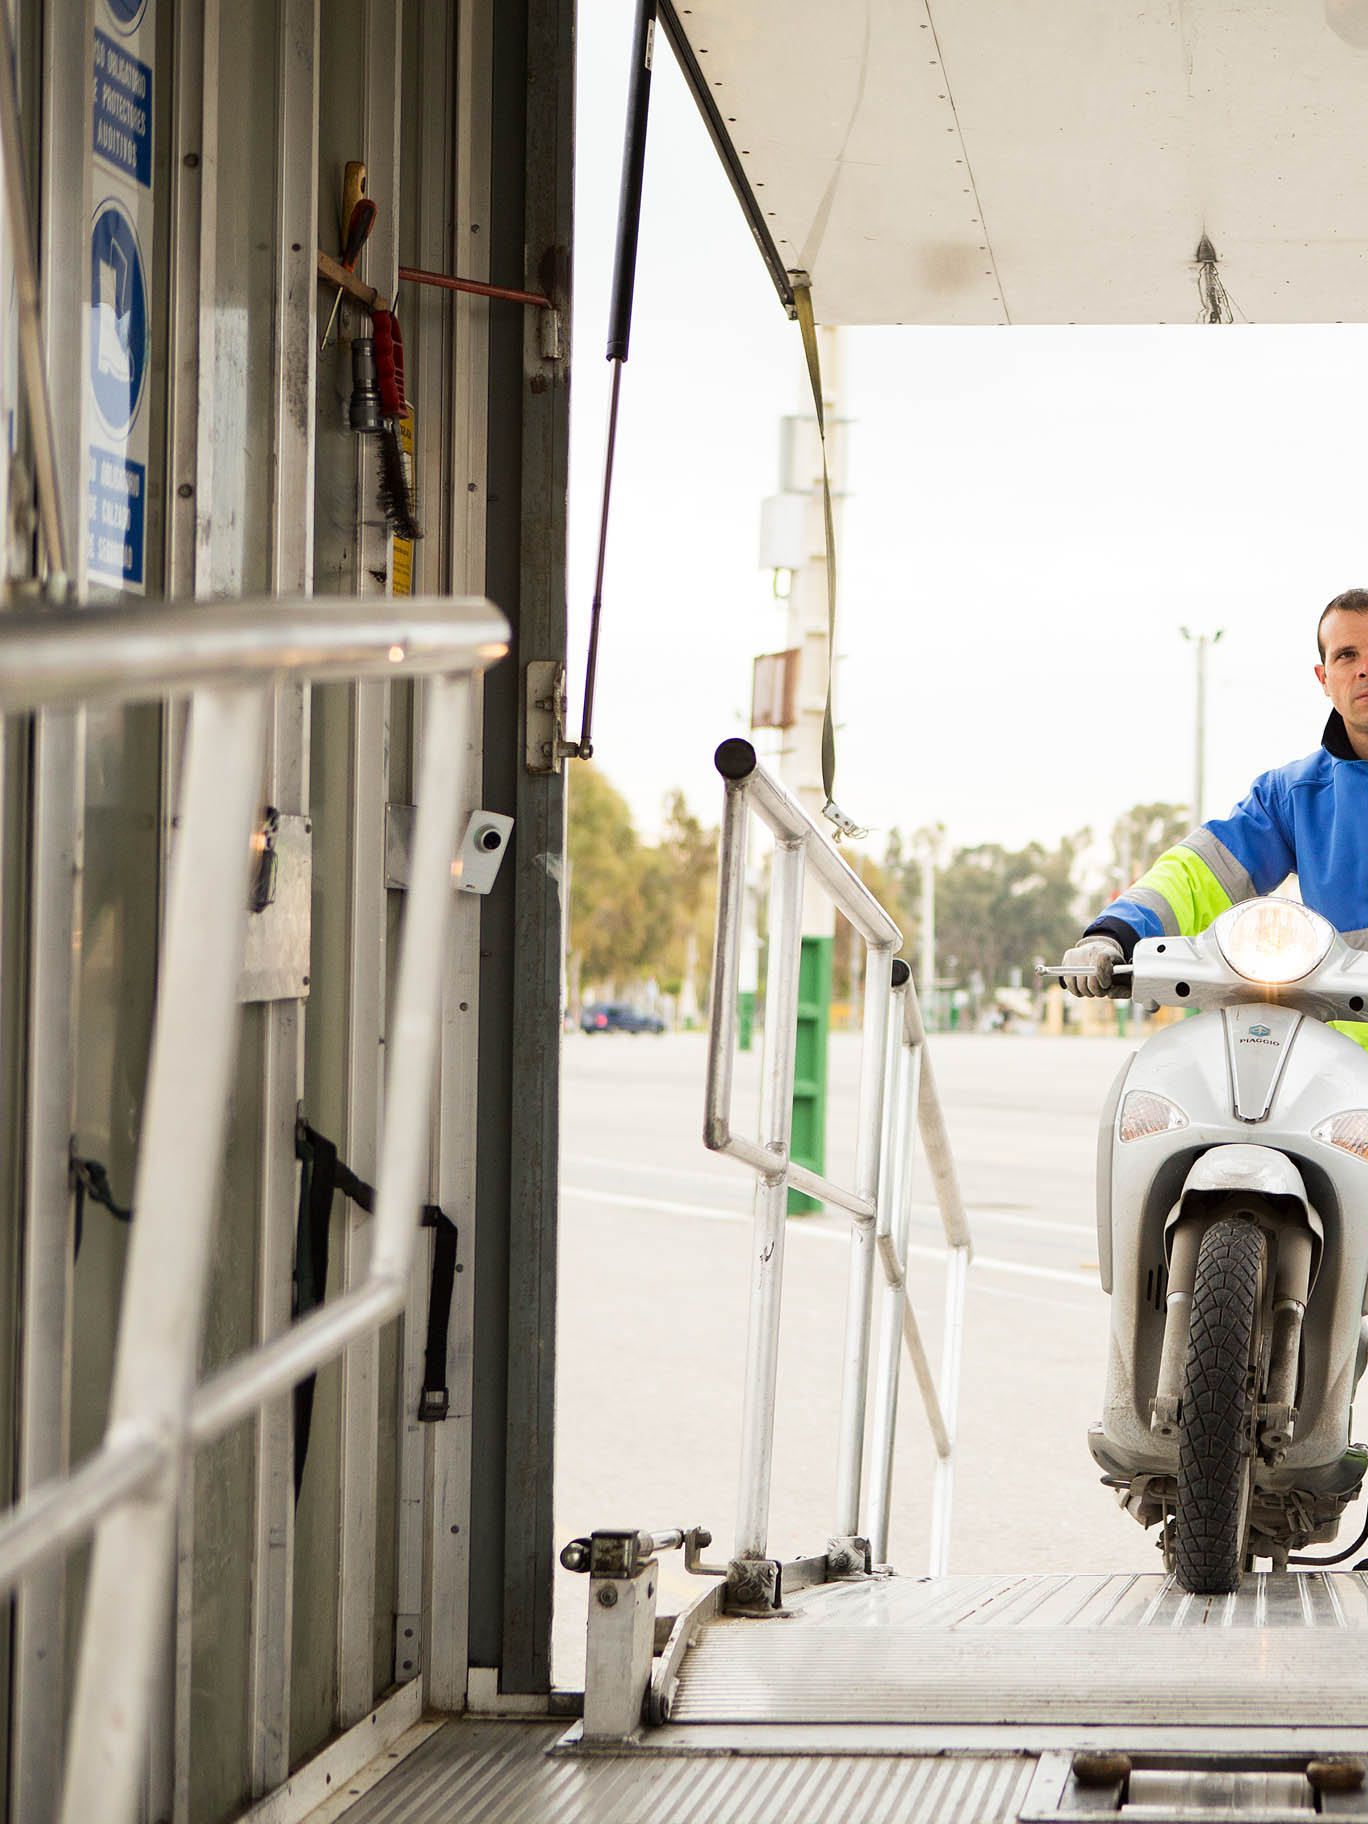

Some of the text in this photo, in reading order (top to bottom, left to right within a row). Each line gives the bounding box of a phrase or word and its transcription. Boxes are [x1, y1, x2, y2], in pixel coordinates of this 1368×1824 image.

[102, 82, 146, 137] PROTECTORES
[97, 118, 137, 168] AUDITIVOS
[1239, 1038, 1280, 1046] PIAGGIO
